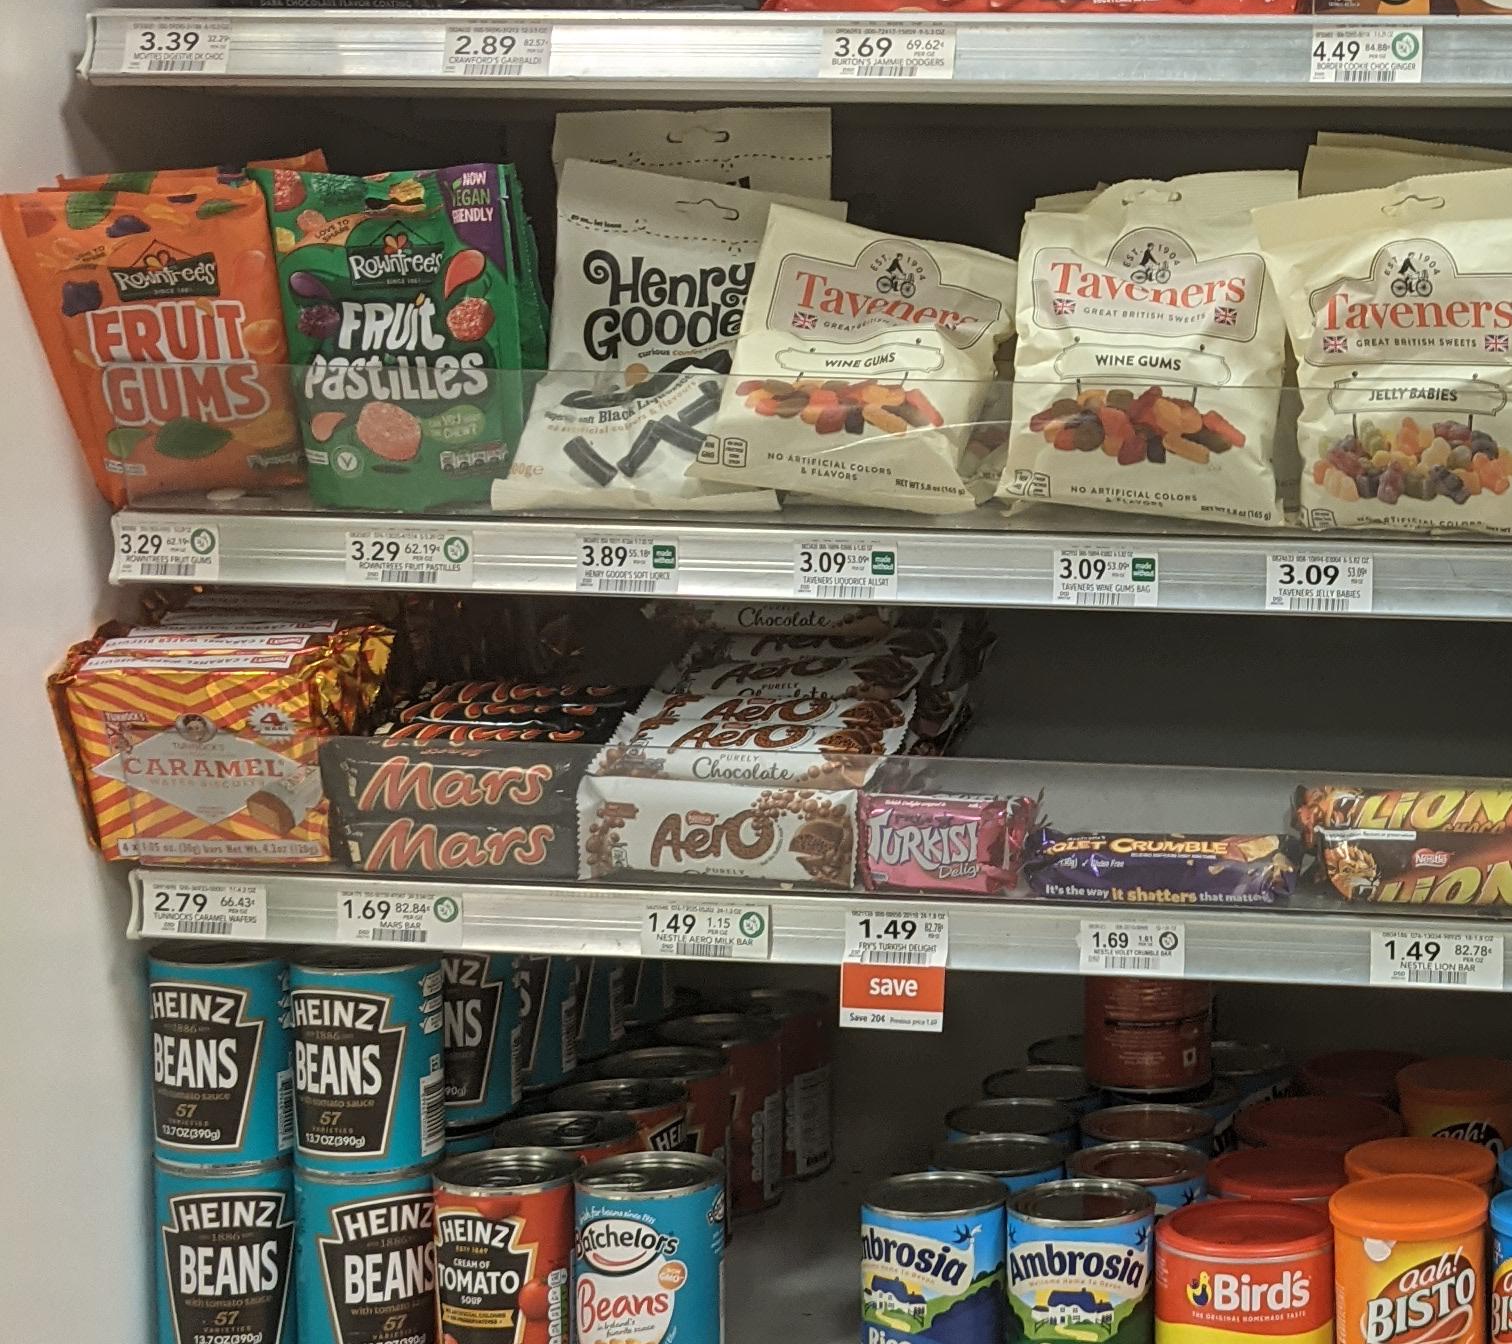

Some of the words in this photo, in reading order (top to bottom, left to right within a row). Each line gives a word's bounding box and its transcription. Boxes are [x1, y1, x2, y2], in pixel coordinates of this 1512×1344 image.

[89, 300, 246, 363] FRUIT
[1095, 355, 1134, 368] WINE
[1138, 355, 1181, 371] GUMS
[102, 368, 272, 426] GUMS
[1369, 388, 1405, 402] JELLY
[1409, 389, 1457, 402] BABIES
[351, 541, 399, 561] 3.29
[124, 756, 283, 778] CARAMEL
[358, 756, 553, 811] Mars
[178, 1200, 275, 1230] HEINZ
[180, 1240, 278, 1296] BEANS
[1009, 1247, 1143, 1288] Ambrosia
[579, 1276, 669, 1332] Beans
[1213, 1273, 1309, 1312] Bird's
